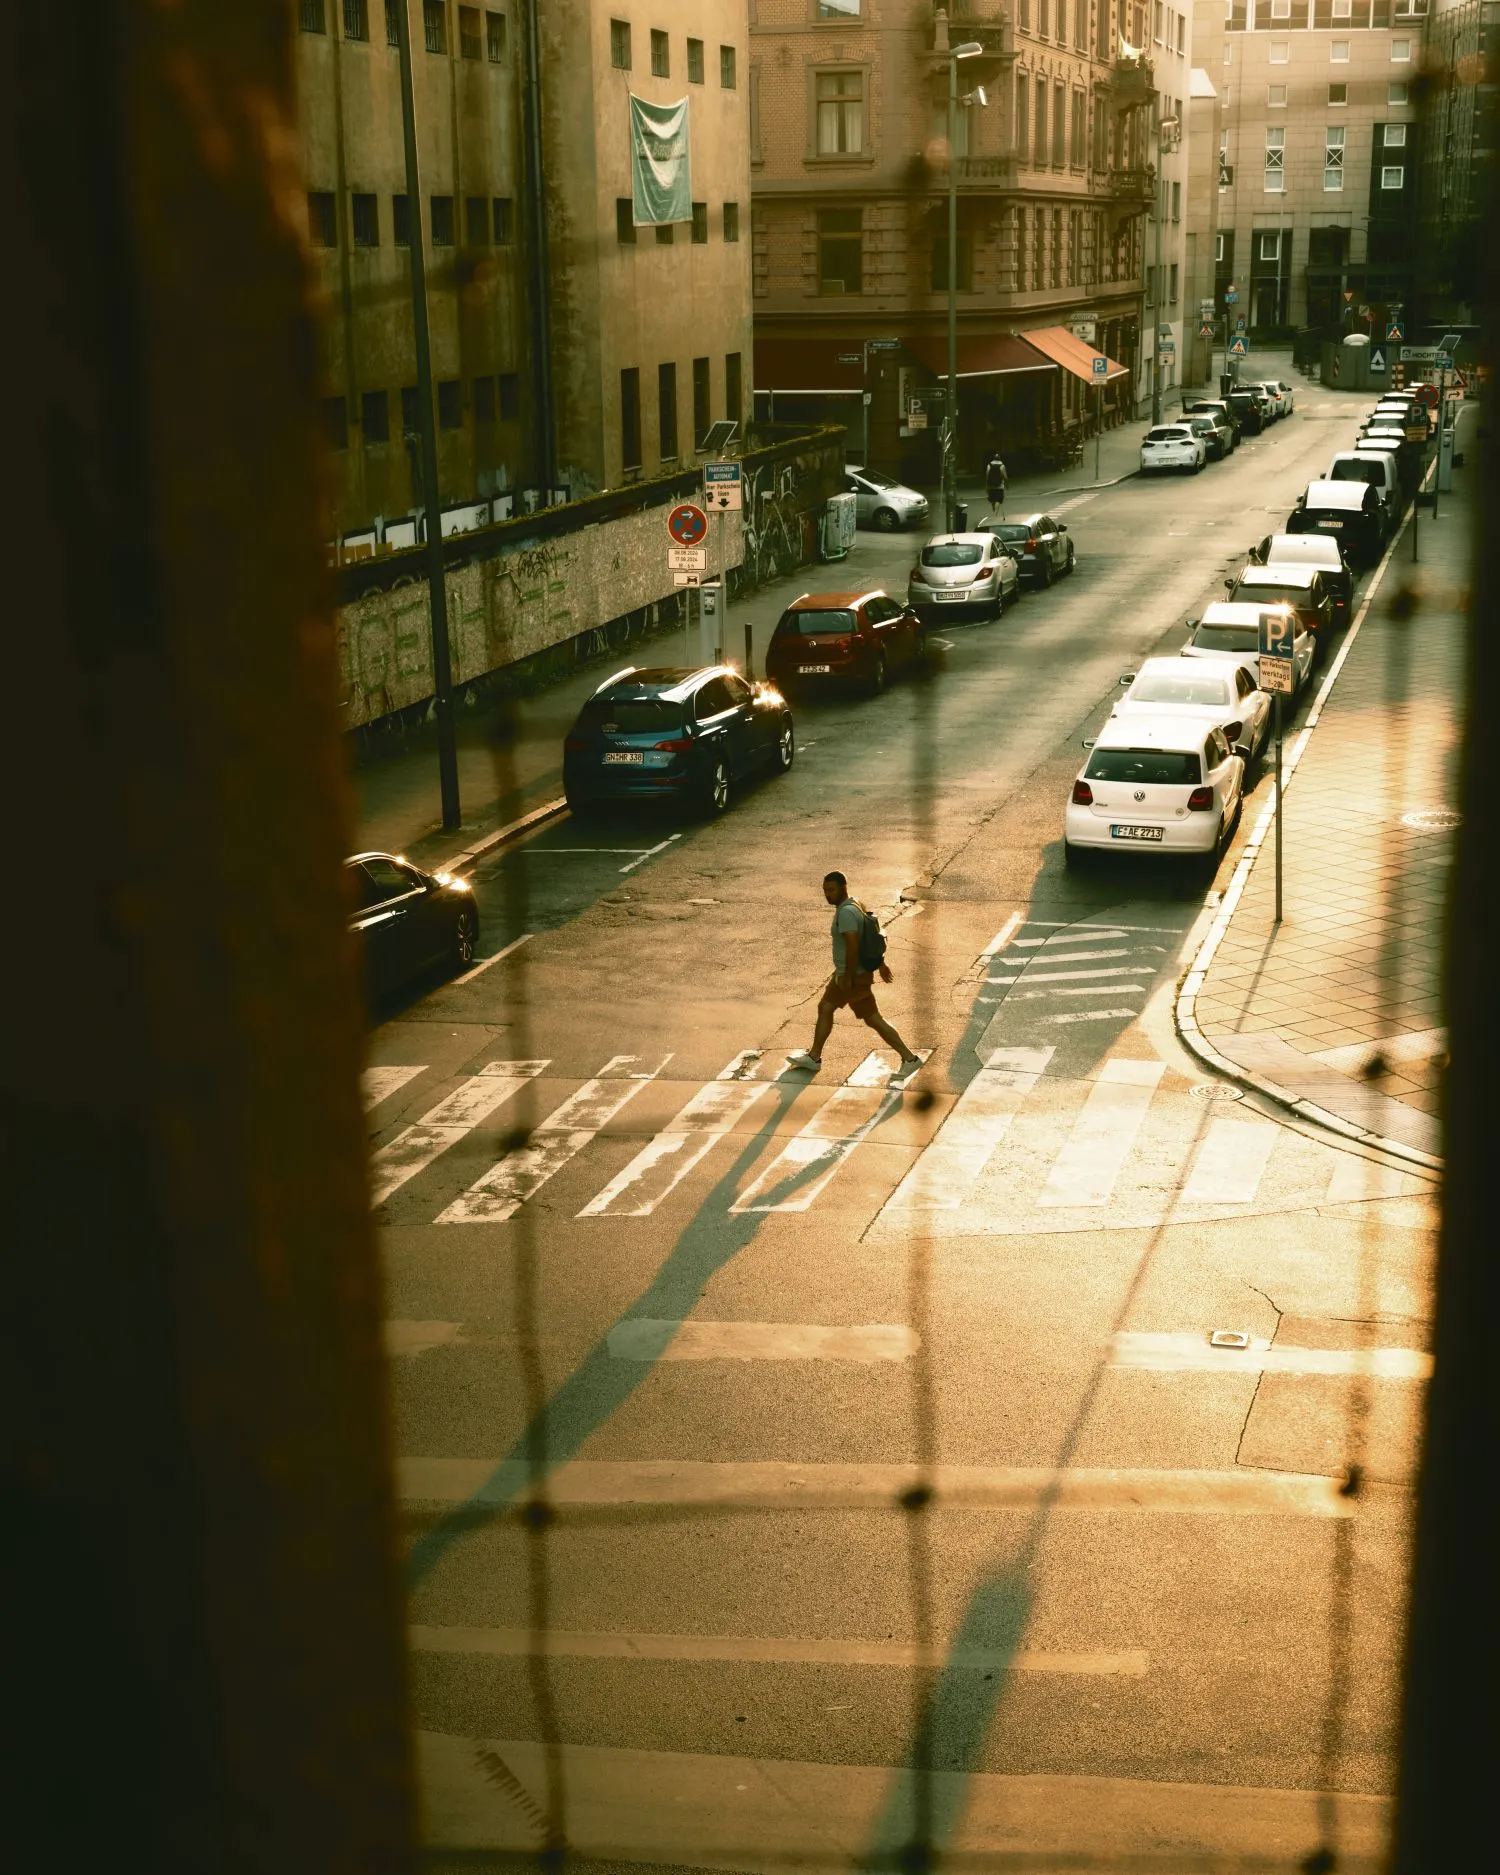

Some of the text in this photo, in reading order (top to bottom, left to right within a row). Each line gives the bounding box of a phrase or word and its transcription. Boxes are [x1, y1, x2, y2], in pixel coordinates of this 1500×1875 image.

[1094, 359, 1103, 372] P
[911, 399, 921, 413] P
[1411, 407, 1422, 422] P
[1267, 618, 1286, 651] P
[1262, 670, 1290, 681] werktags
[1140, 828, 1161, 838] 2713
